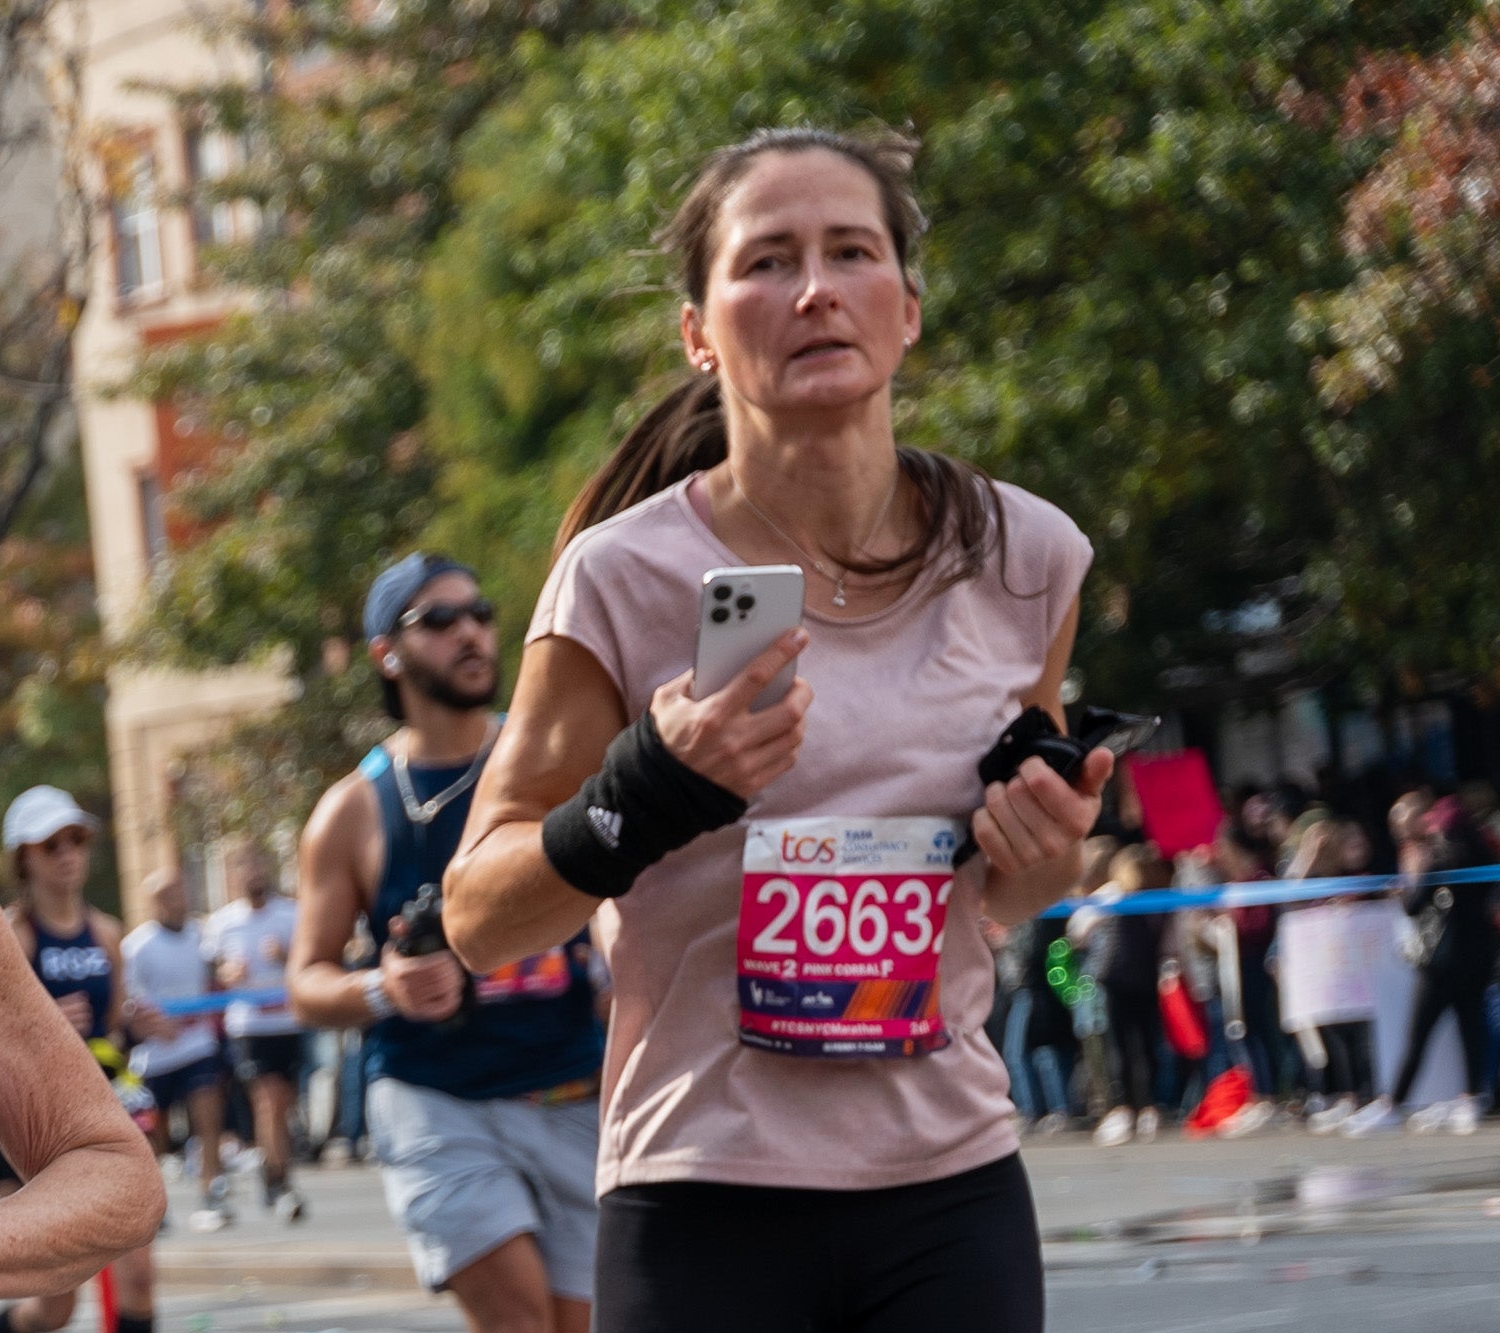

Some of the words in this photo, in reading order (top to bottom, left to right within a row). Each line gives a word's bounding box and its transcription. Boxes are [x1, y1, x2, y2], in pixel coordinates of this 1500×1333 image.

[781, 829, 837, 864] tcs
[925, 853, 952, 865] TAT
[780, 959, 798, 979] 2
[802, 961, 834, 976] PINK
[880, 959, 894, 978] F
